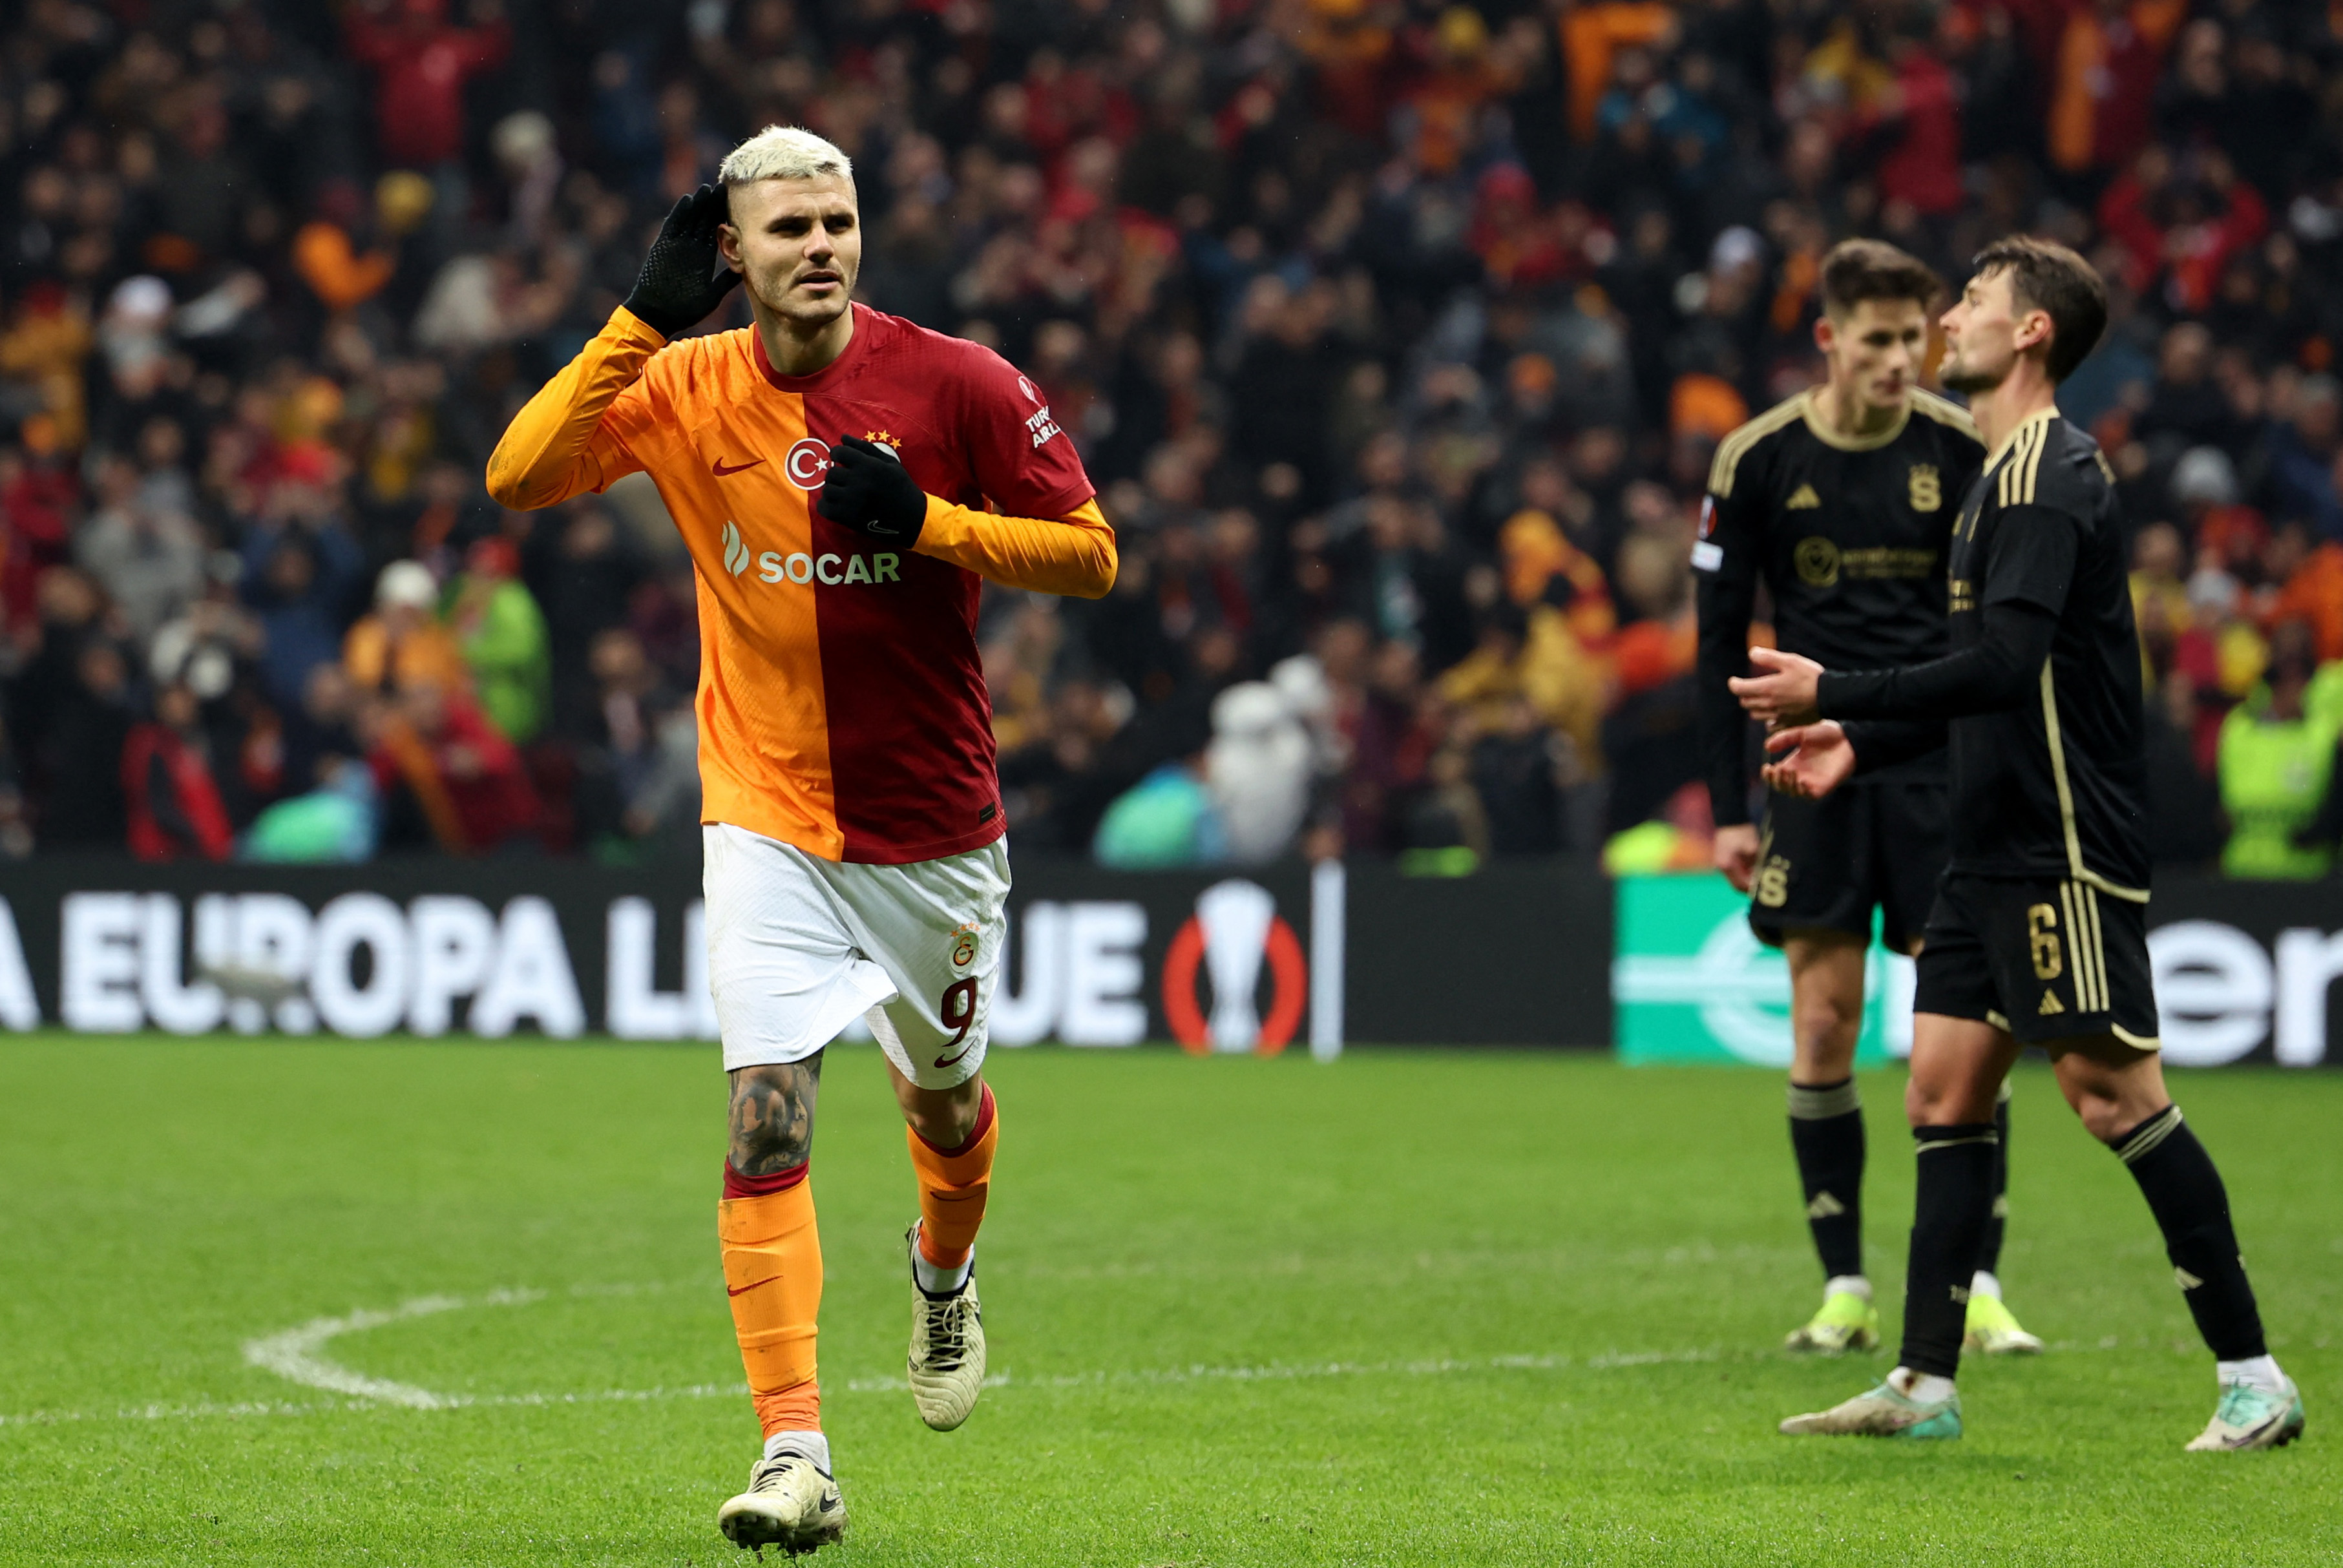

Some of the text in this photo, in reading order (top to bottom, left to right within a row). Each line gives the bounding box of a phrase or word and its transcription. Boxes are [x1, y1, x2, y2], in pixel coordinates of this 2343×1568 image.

[758, 552, 901, 585] SOCAR
[61, 891, 586, 1039] EUROPA
[2028, 903, 2062, 980] 6
[941, 976, 978, 1047] 9
